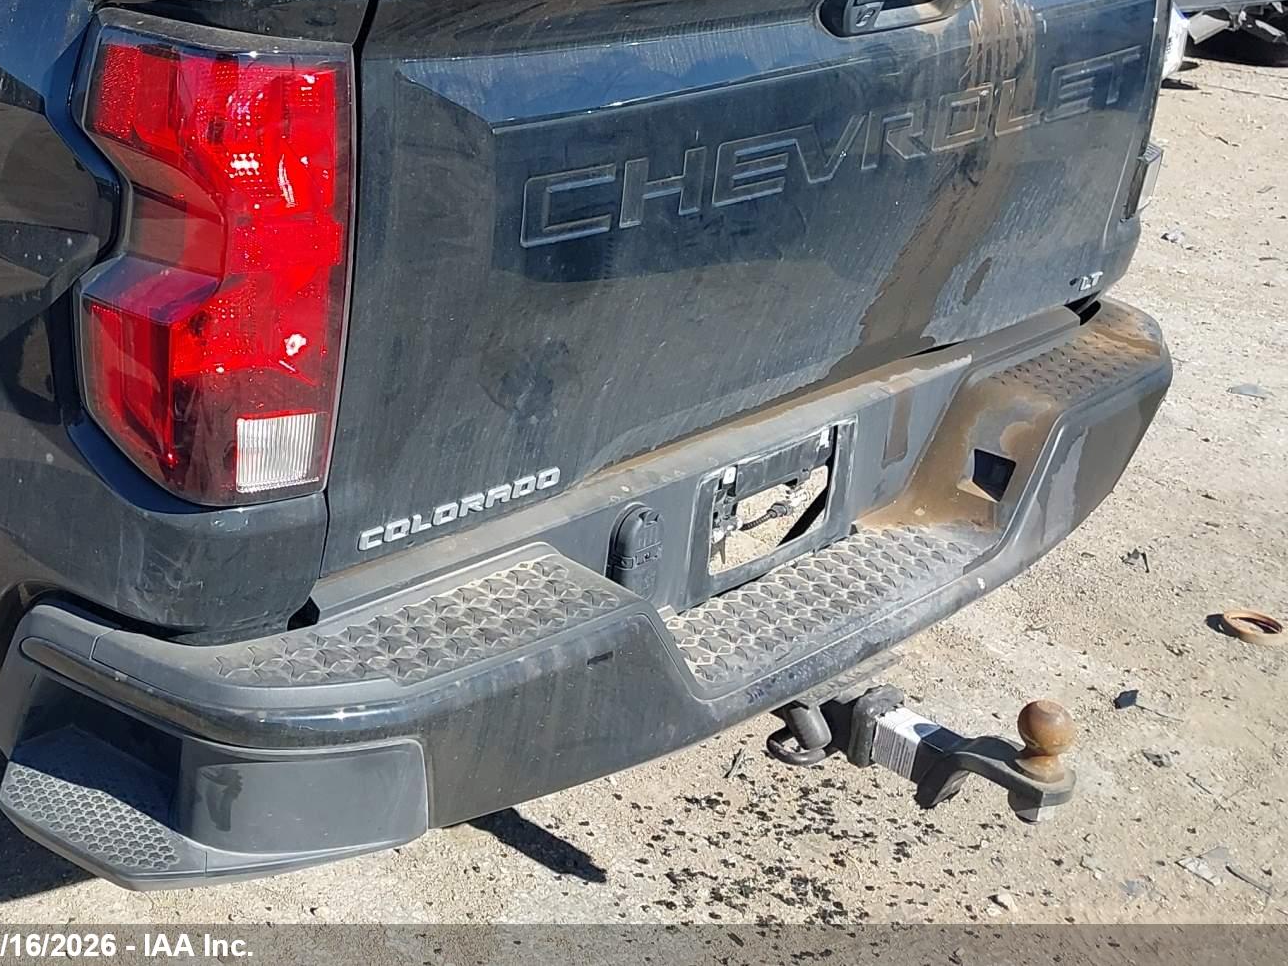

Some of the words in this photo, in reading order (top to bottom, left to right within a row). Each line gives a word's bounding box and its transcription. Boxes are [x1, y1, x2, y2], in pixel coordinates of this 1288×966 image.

[519, 45, 1141, 248] CHEVROLET
[1079, 270, 1104, 291] LT
[357, 466, 561, 551] COLORADO
